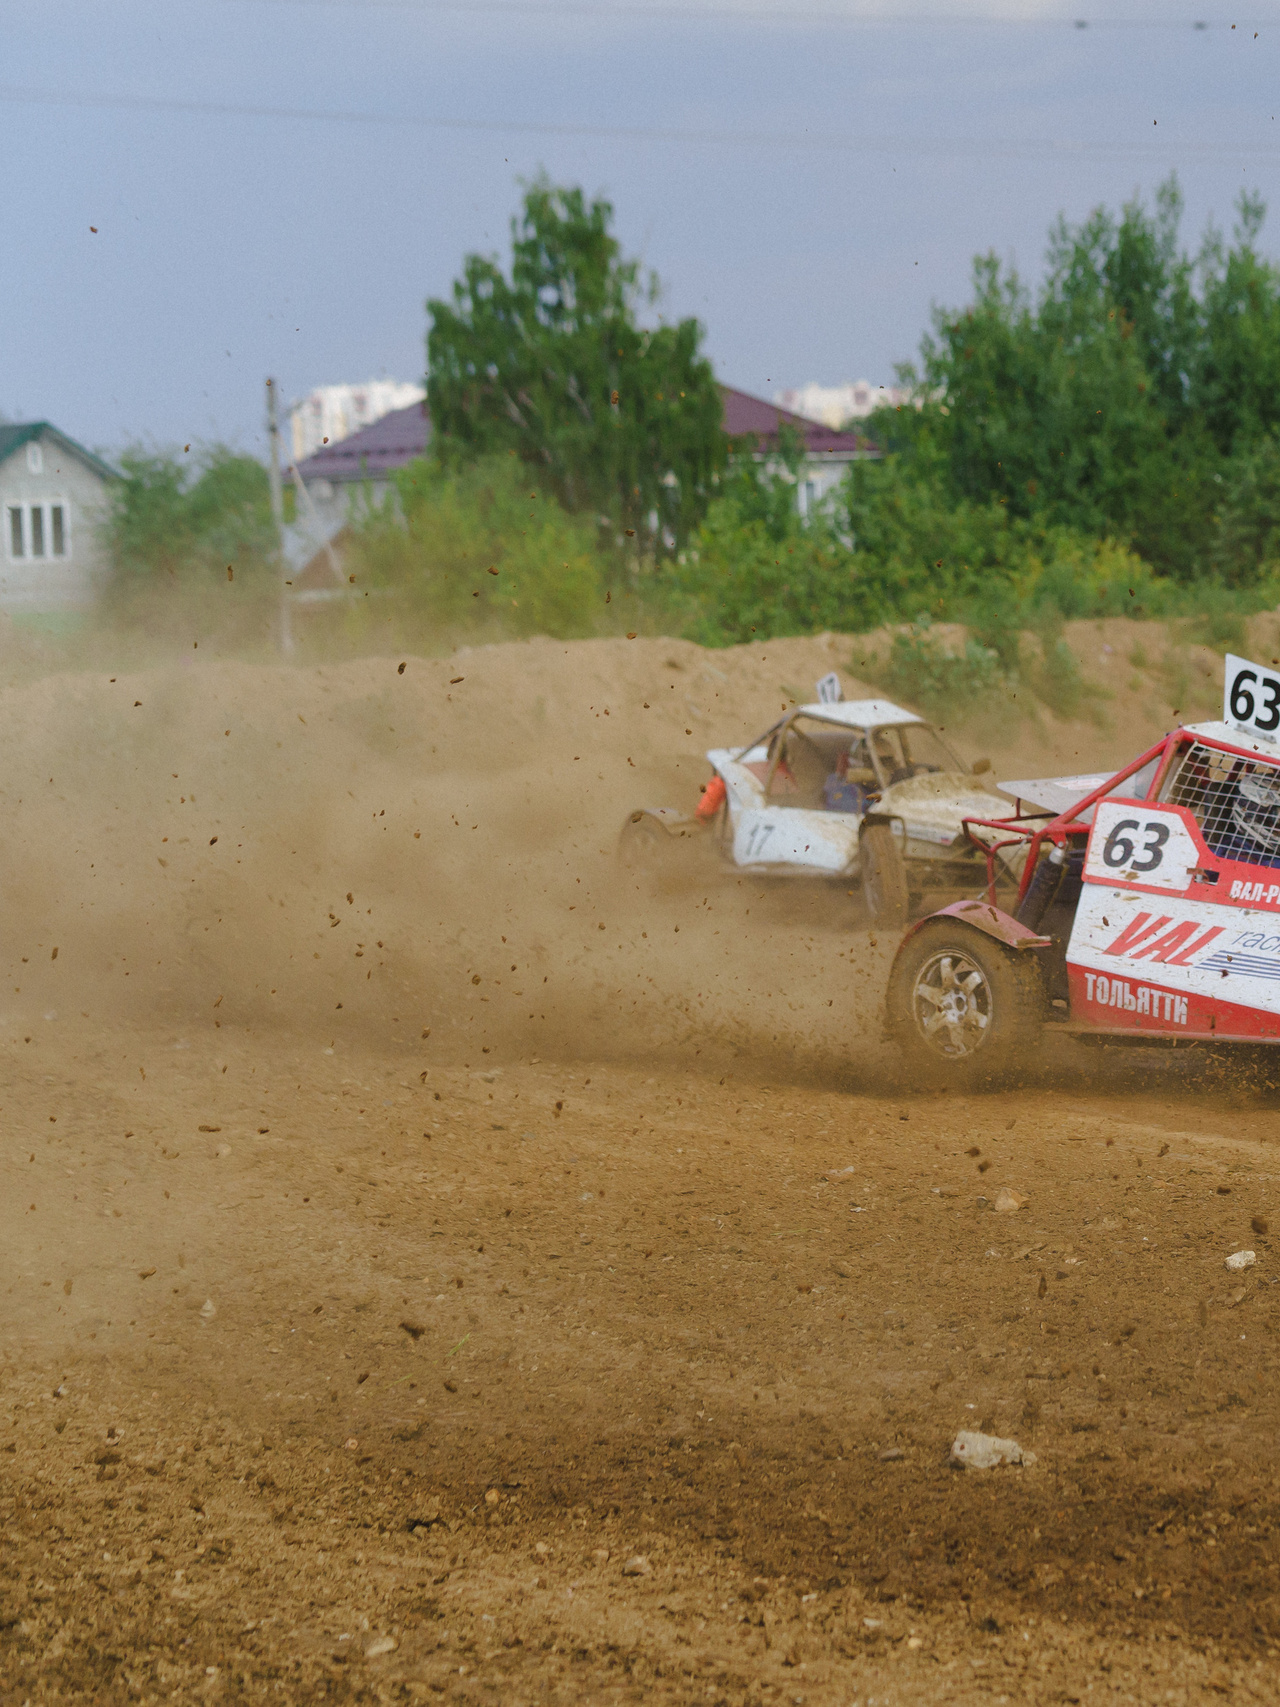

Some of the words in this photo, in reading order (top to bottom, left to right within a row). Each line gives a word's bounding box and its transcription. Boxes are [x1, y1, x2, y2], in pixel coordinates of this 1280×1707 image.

[746, 824, 775, 856] 17
[1102, 819, 1170, 872] 63
[1102, 911, 1227, 967] VAL
[1084, 972, 1188, 1025] ТОЛЬЯТТИ
